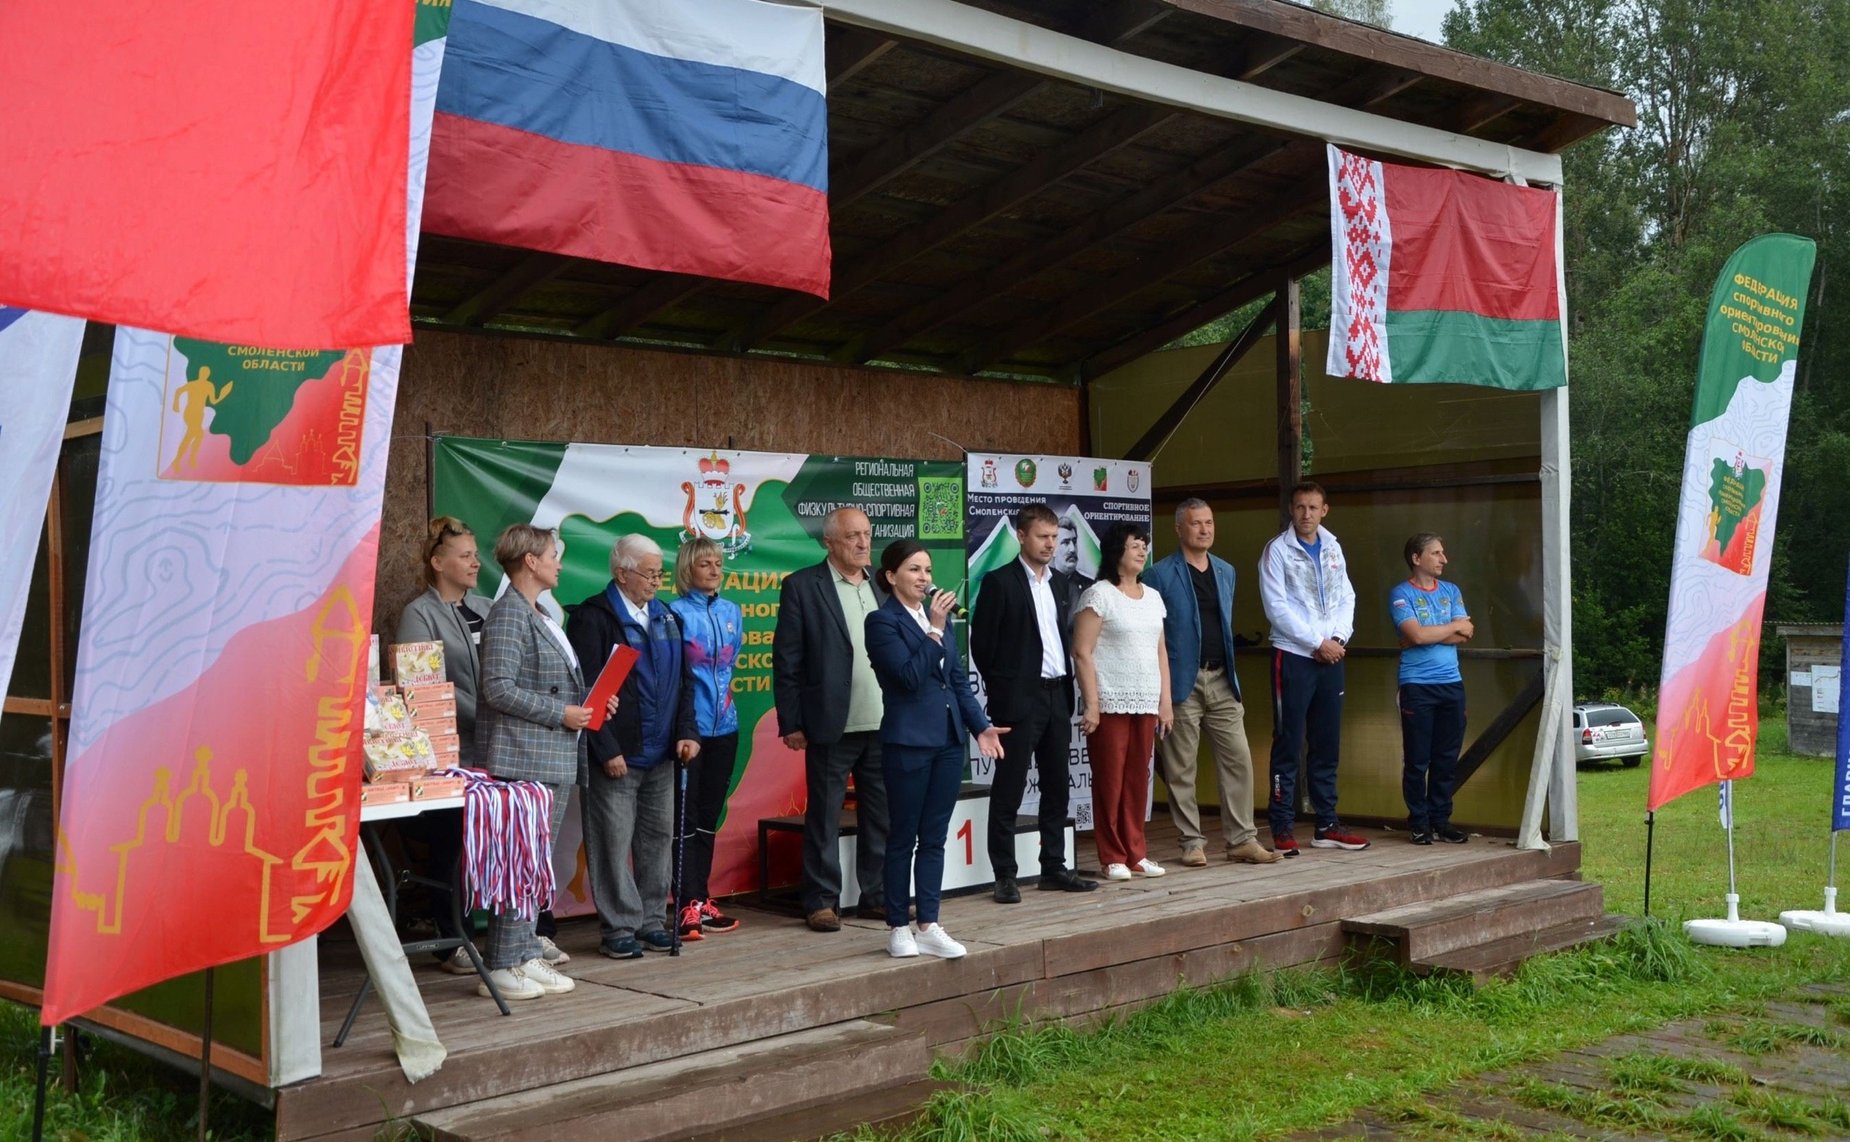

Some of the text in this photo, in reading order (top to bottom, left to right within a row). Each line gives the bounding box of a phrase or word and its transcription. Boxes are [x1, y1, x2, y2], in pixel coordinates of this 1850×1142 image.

[242, 359, 305, 372] ОБЛАСТИ
[855, 461, 914, 477] РЕГИОНАЛЬНАЯ
[852, 482, 915, 498] ОБЩЕСТВЕННАЯ
[1103, 502, 1150, 512] СПОРТИВНОЕ
[1084, 512, 1150, 523] ОРИЕНТИРОВАНИЕ
[870, 523, 915, 539] ГАНИЗАЦИЯ
[957, 819, 973, 865] 1
